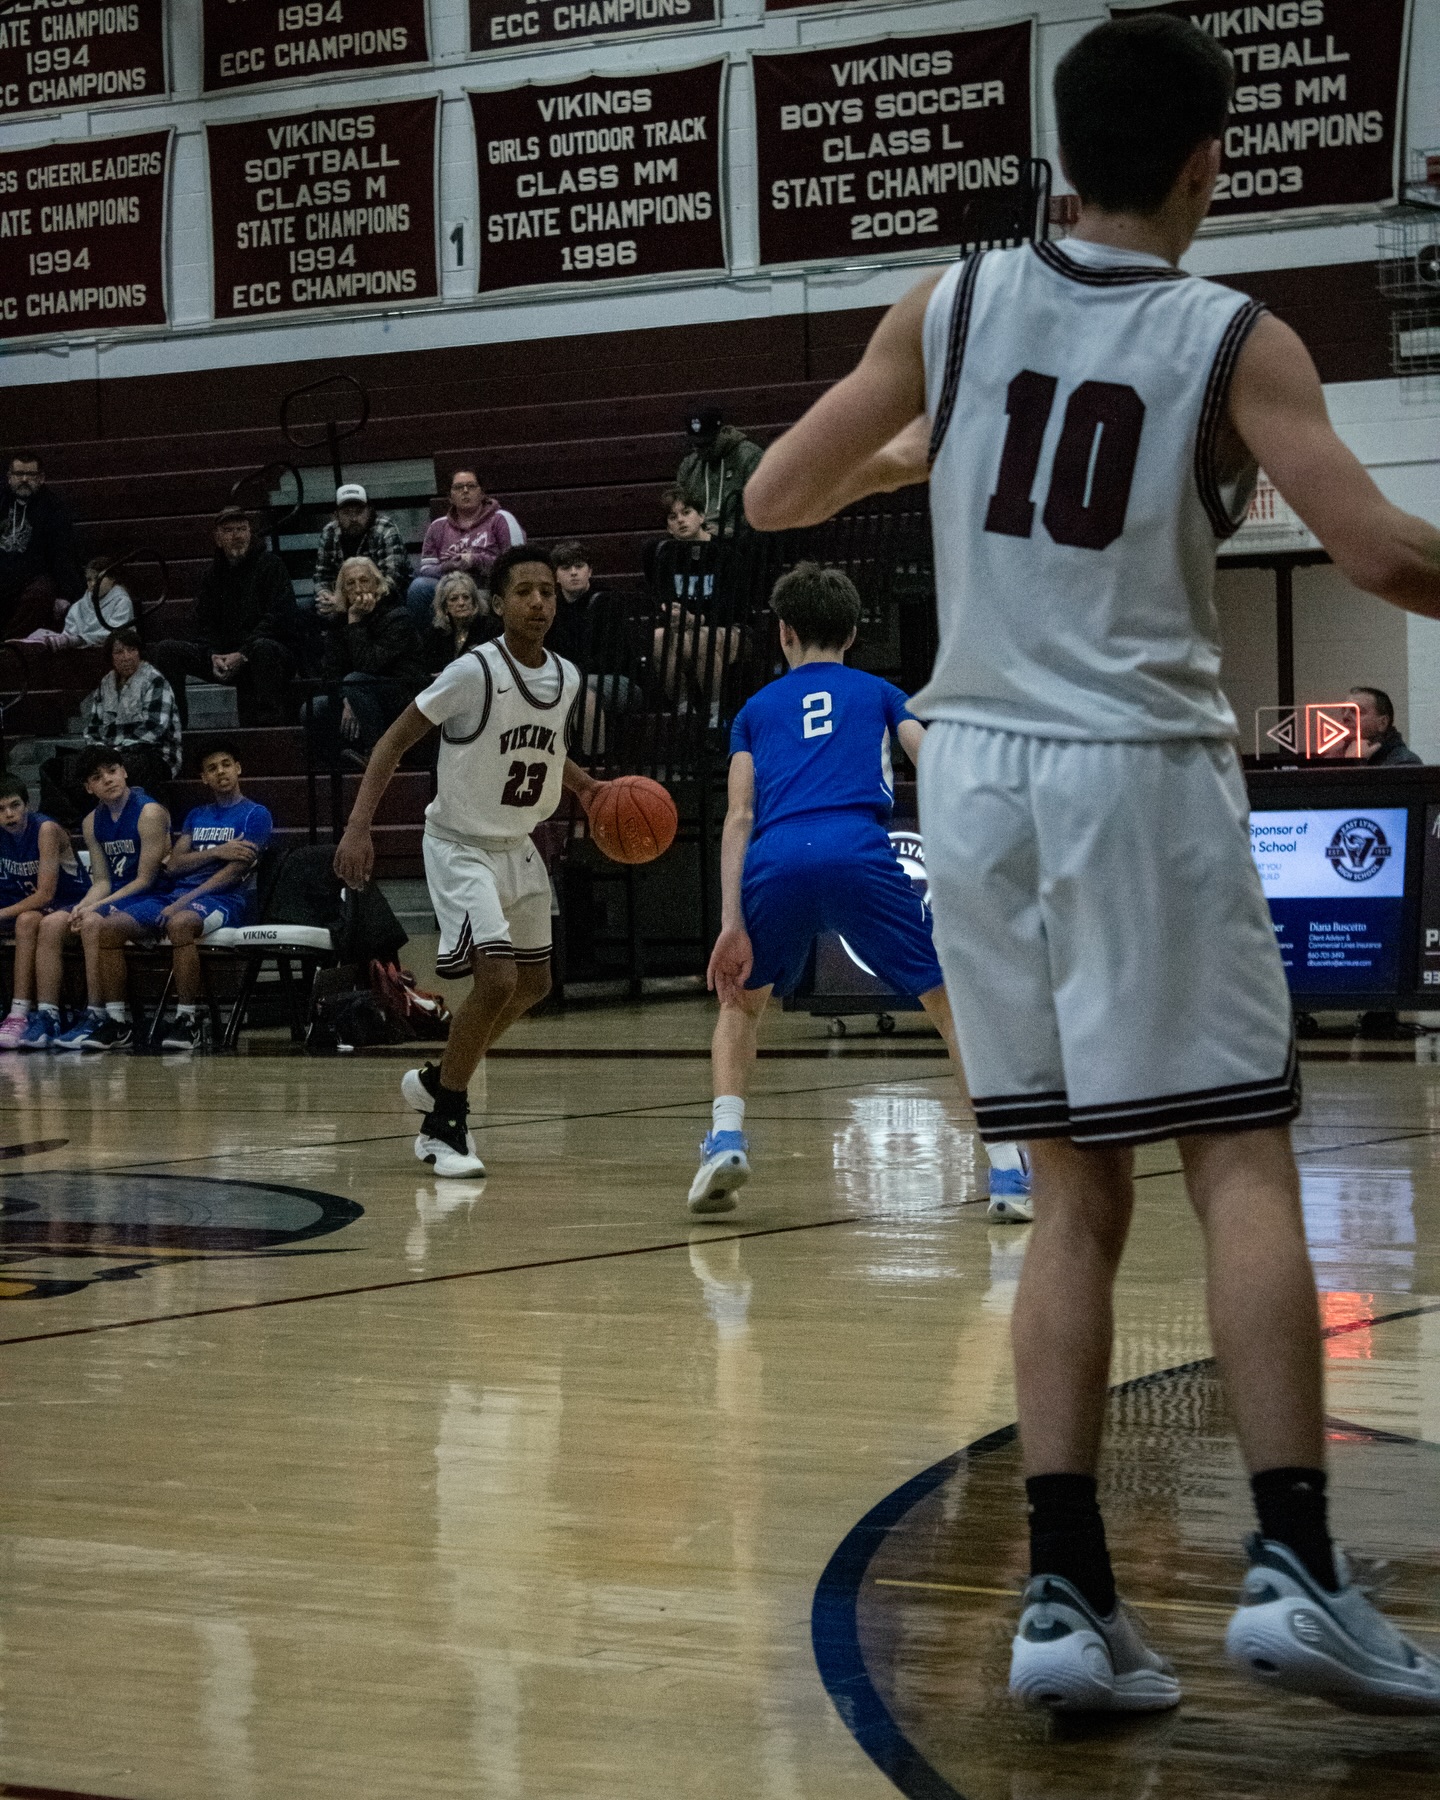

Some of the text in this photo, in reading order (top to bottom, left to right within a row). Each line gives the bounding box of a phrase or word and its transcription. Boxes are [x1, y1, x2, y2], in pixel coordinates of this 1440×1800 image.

[41, 4, 139, 43] CHAMPIONS
[278, 0, 344, 31] 1994
[491, 0, 691, 41] ECC CHAMPIONS
[1190, 0, 1324, 38] VIKINGS
[26, 44, 90, 75] 1994
[220, 27, 408, 77] ECC CHAMPIONS
[831, 49, 953, 87] VIKINGS
[28, 67, 146, 104] CHAMPIONS
[1227, 74, 1347, 114] SS MM
[537, 88, 652, 122] VIKINGS
[780, 80, 1005, 131] BOYS SOCCER
[267, 115, 375, 150] VIKINGS
[488, 116, 707, 165] GIRLS OUTDOOR TRACK
[822, 123, 964, 163] CLASS L
[1224, 110, 1384, 159] CHAMPIONS
[26, 151, 162, 191] CHEERLEADERS
[245, 143, 400, 183] SOFTBALL
[517, 157, 678, 198] CLASS MM
[256, 175, 386, 212] CLASS M
[771, 155, 1020, 210] STATE CHAMPIONS
[1211, 165, 1304, 200] 2003
[40, 196, 140, 233] CHAMPIONS
[237, 204, 410, 249] STATE CHAMPIONS
[488, 191, 712, 243] STATE CHAMPIONS
[851, 207, 939, 240] 2002
[29, 247, 91, 276] 1994
[290, 244, 357, 274] 1994
[450, 222, 464, 267] 1
[561, 240, 638, 271] 1996
[26, 284, 146, 317] CHAMPIONS
[233, 268, 417, 309] ECC CHAMPIONS
[984, 369, 1146, 550] 10
[802, 691, 833, 739] 2
[500, 761, 548, 807] 23
[1250, 823, 1308, 837] Sponsor of
[1258, 841, 1296, 853] School
[243, 931, 278, 940] VIKINGS
[1310, 922, 1332, 932] Diana
[1426, 928, 1440, 948] P
